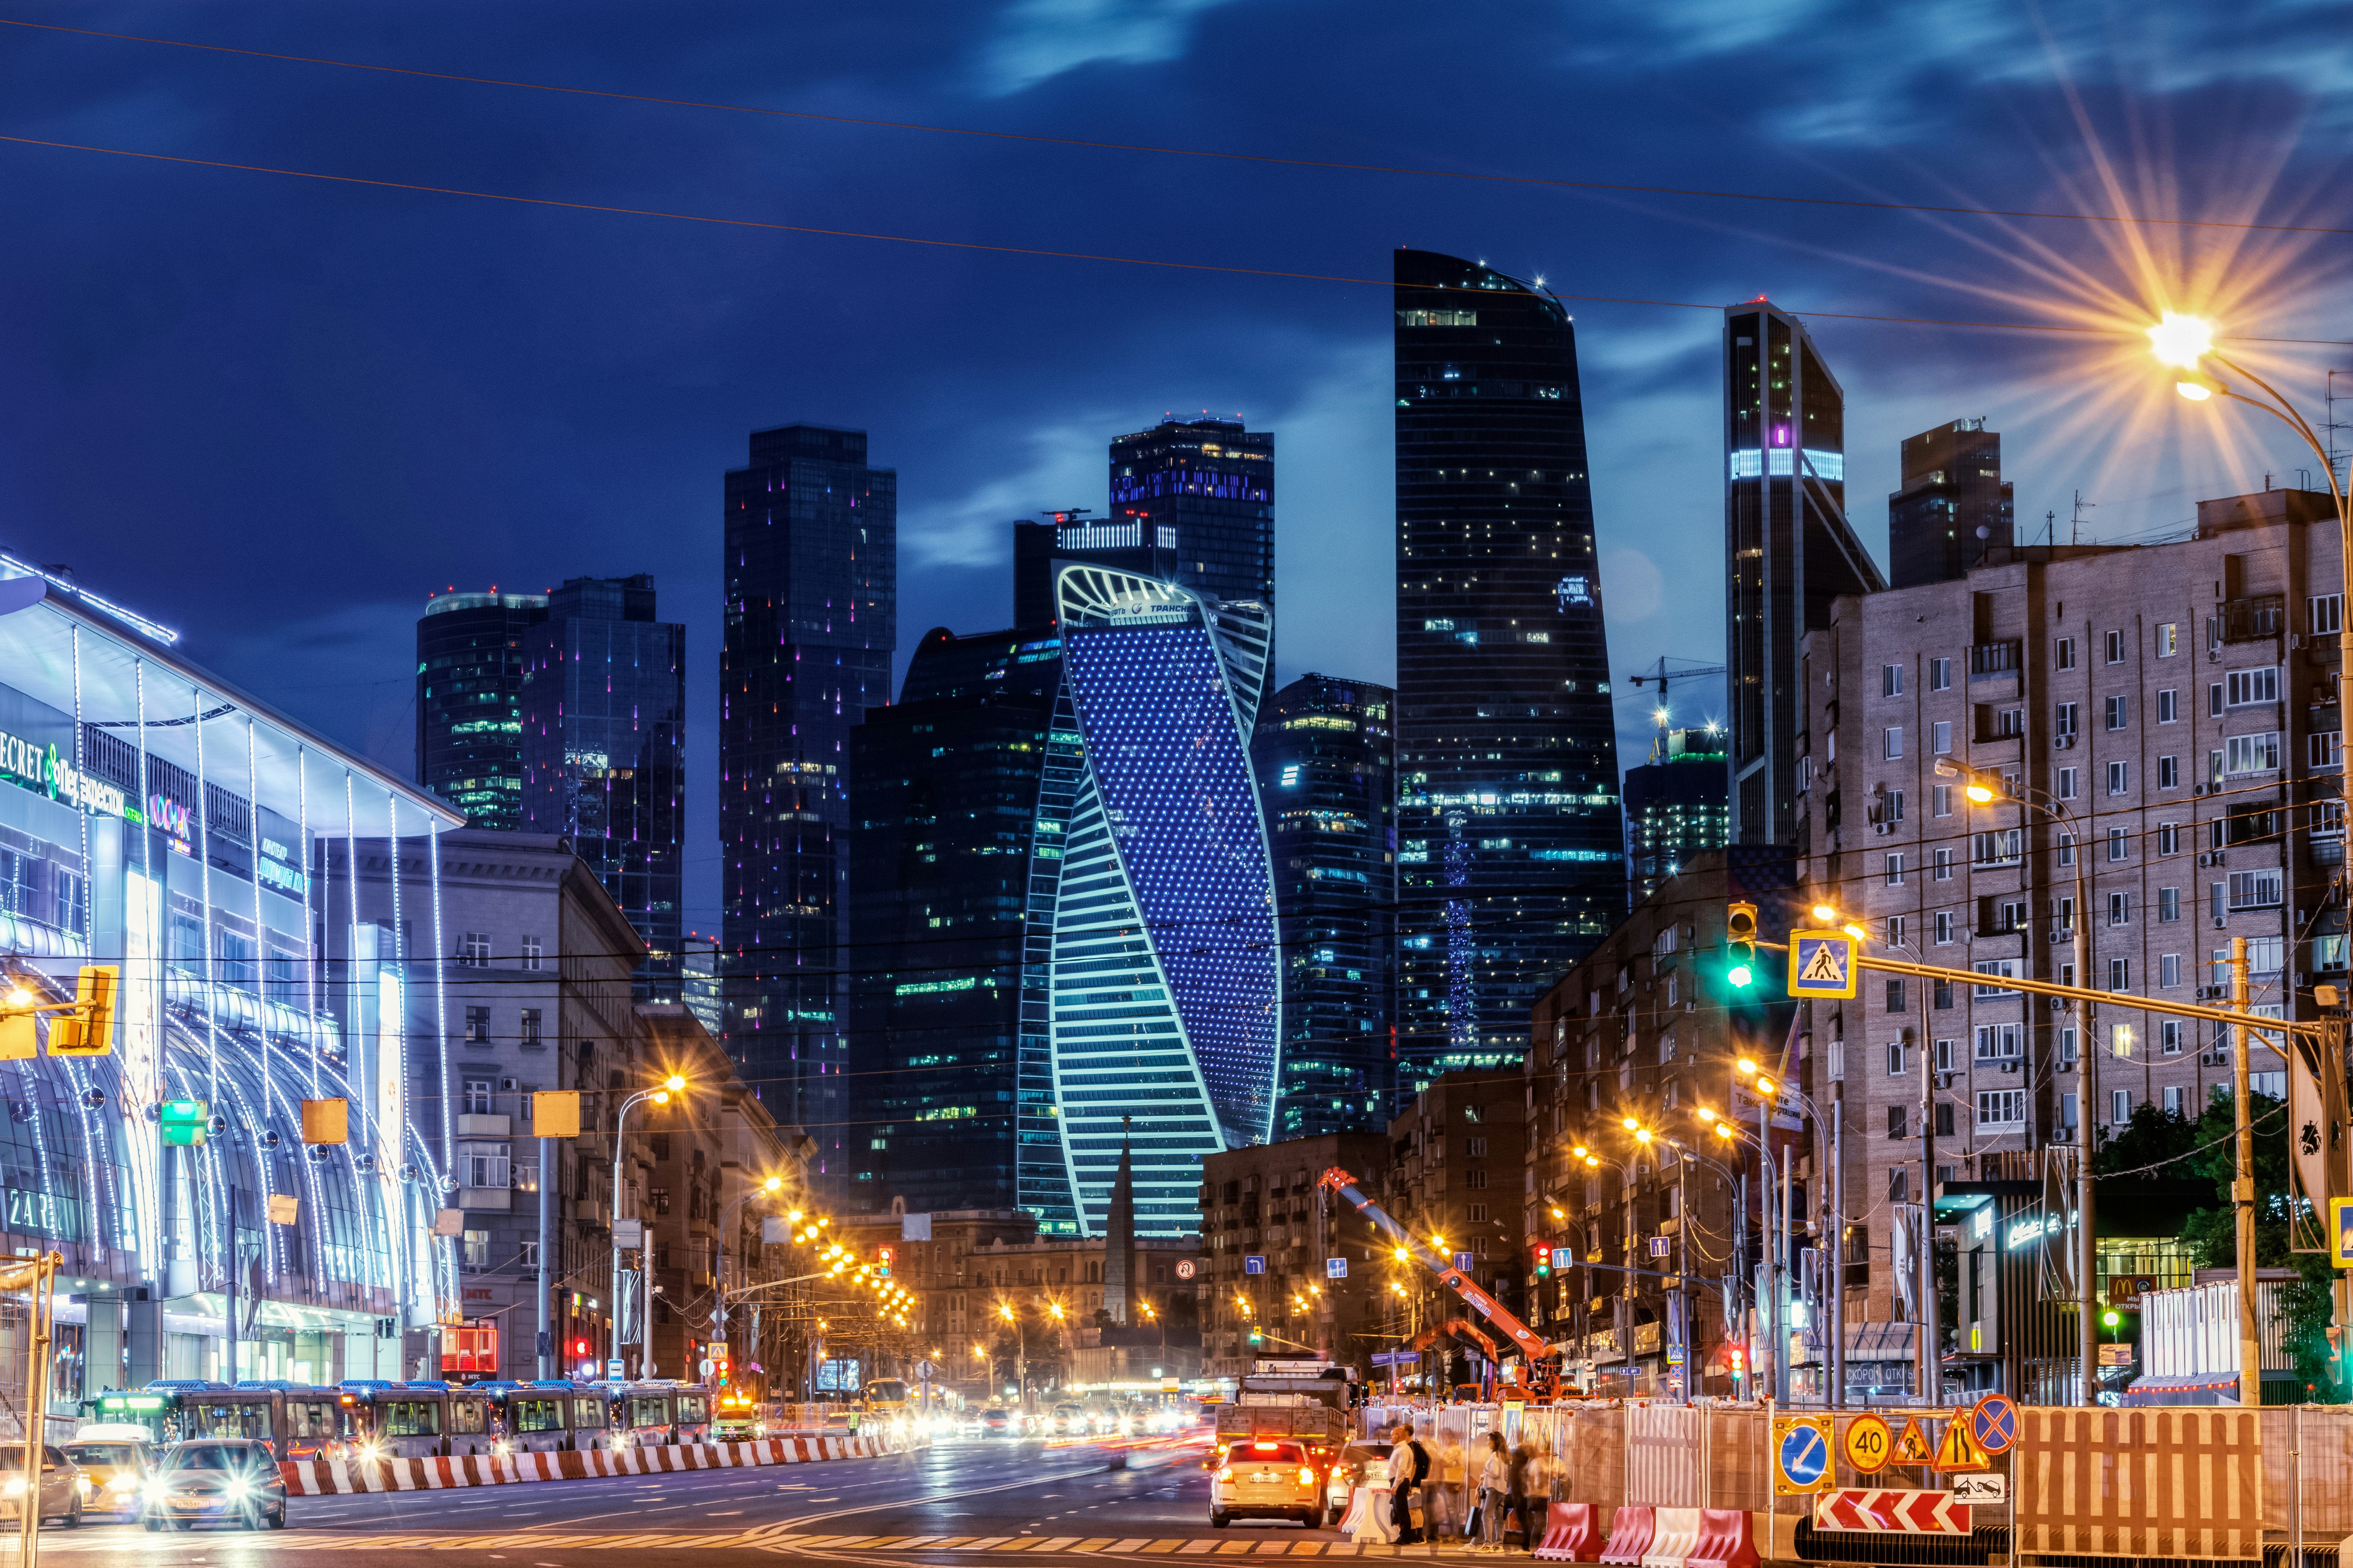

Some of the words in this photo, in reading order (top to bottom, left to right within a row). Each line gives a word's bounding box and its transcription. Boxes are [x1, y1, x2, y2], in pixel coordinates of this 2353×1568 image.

[149, 793, 191, 840] КОСМИК
[261, 838, 288, 861] КИНОТЕАТР
[466, 1289, 492, 1300] МТС
[1464, 1290, 1491, 1317] KANGLIM
[1846, 1369, 1874, 1380] СКОРО
[1855, 1431, 1882, 1453] 40
